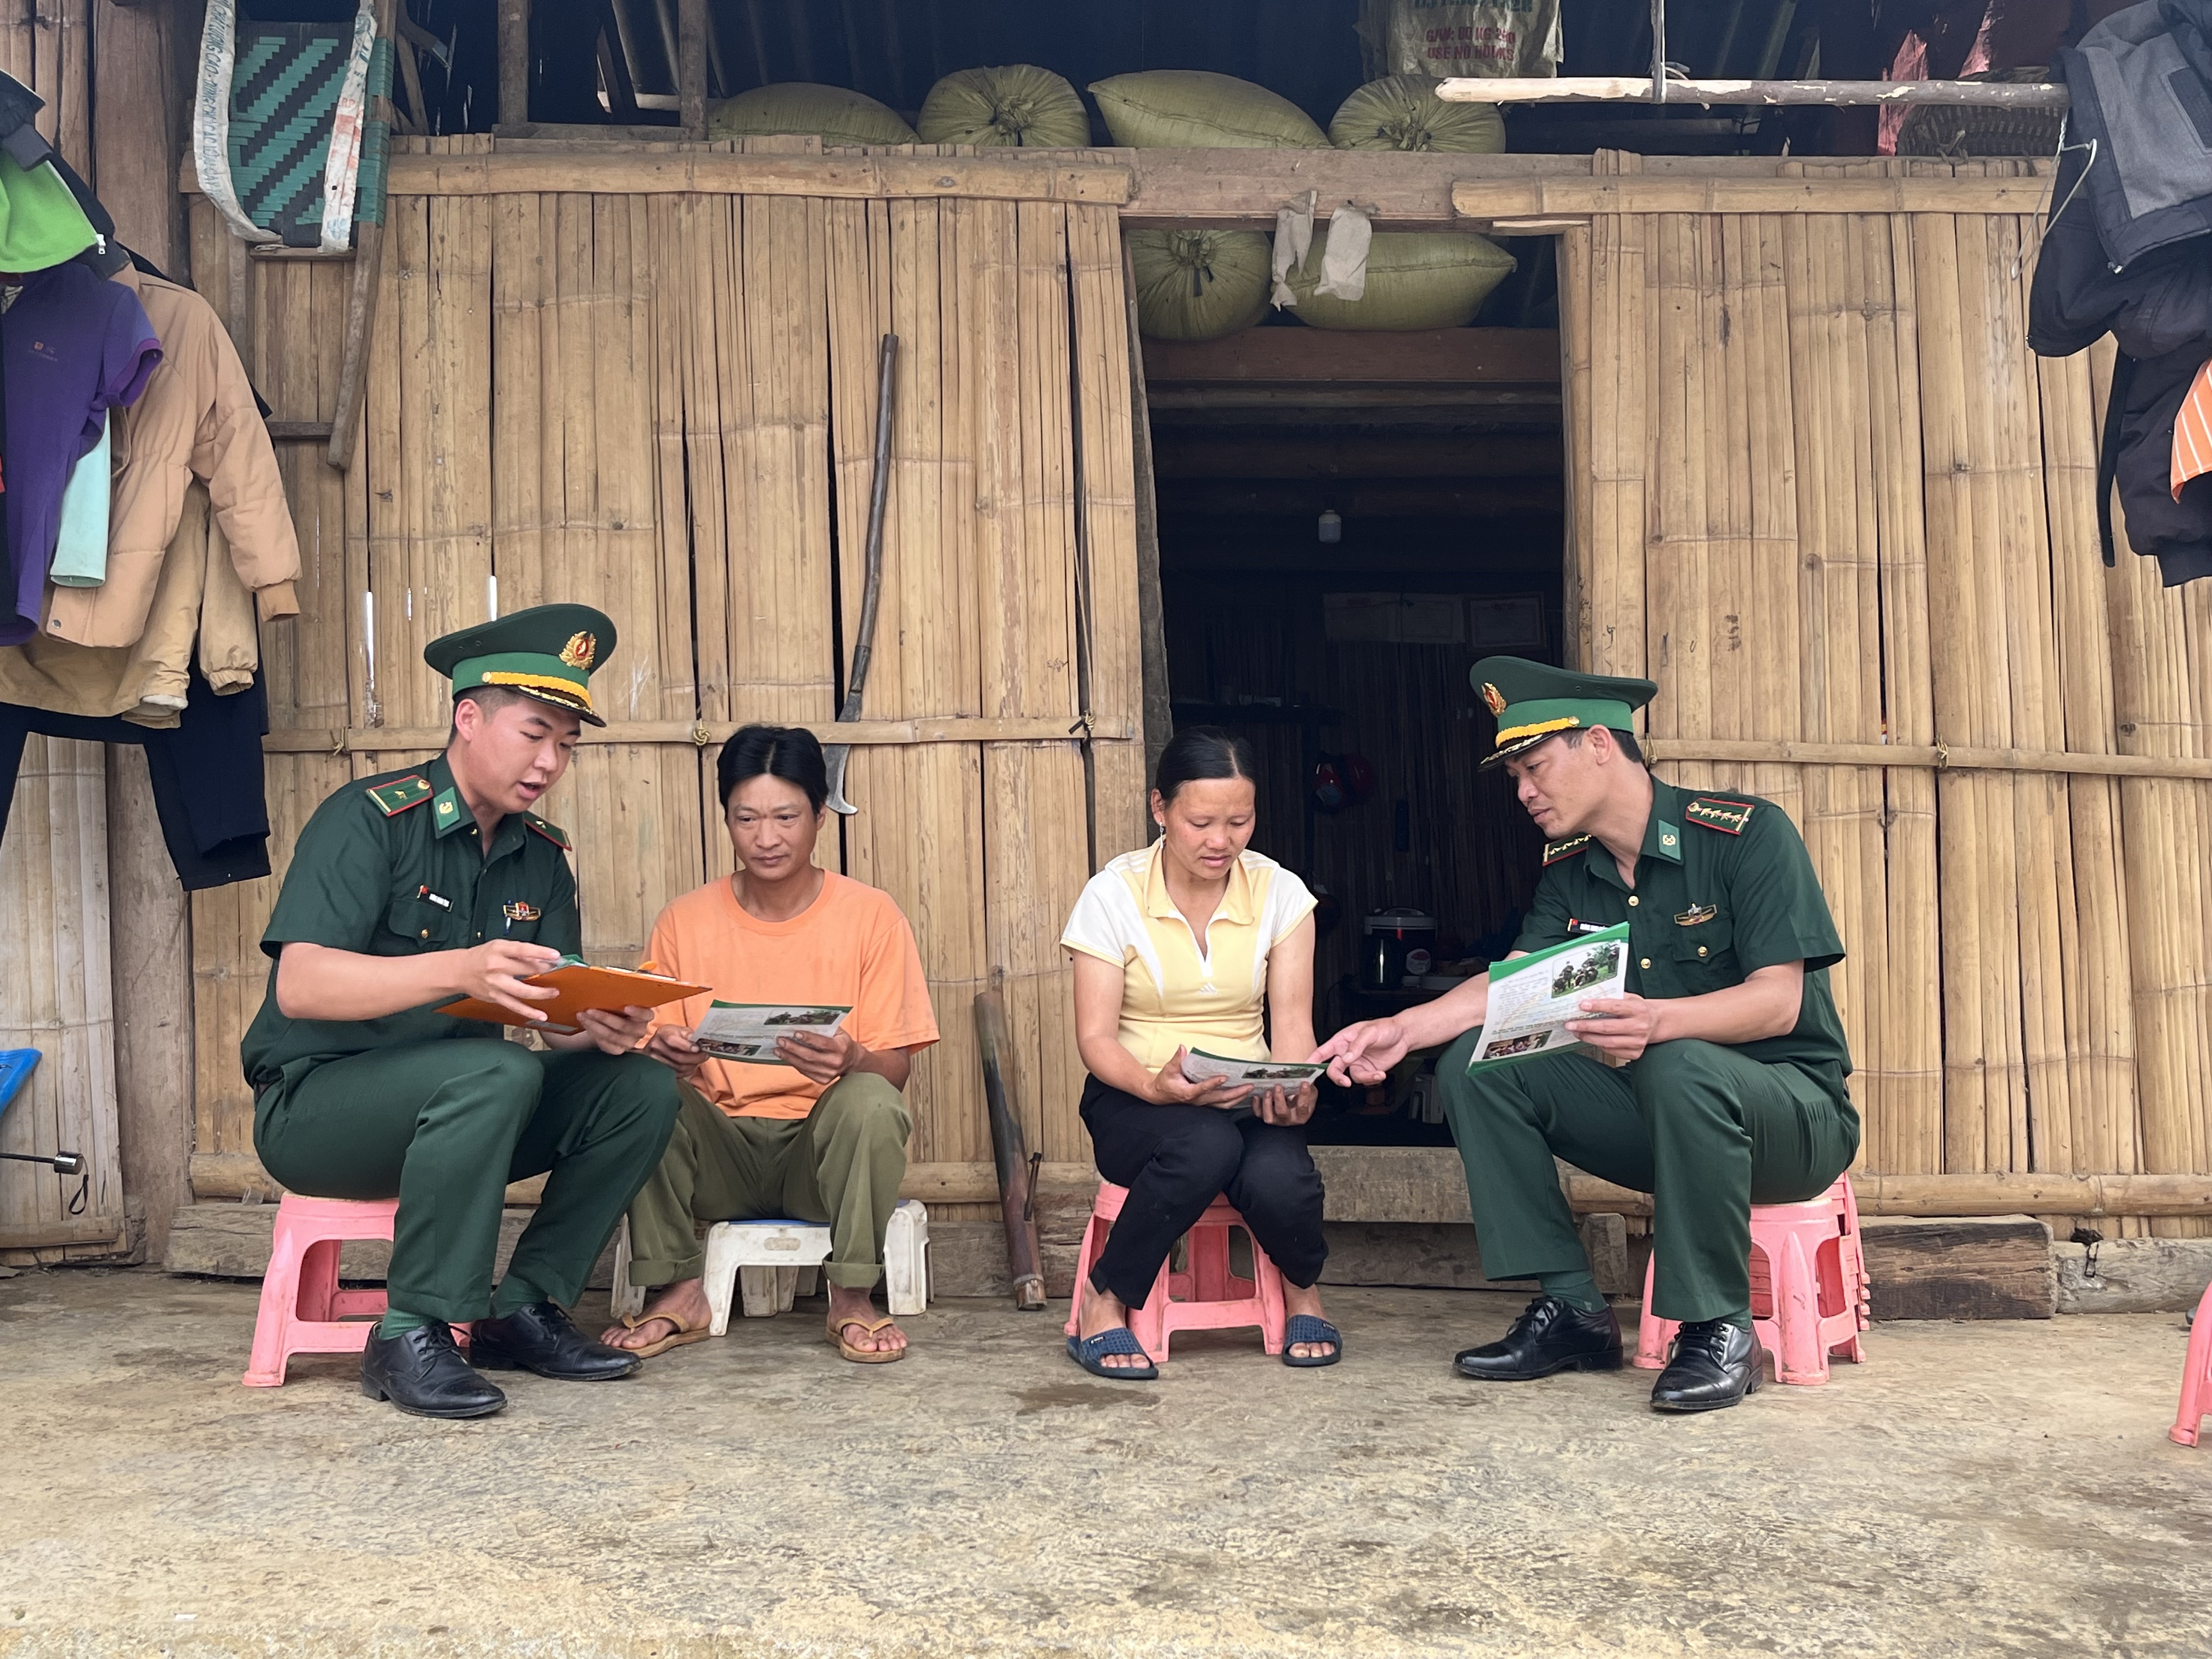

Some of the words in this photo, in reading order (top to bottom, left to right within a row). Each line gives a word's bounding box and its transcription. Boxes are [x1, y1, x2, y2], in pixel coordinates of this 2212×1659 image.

[1427, 46, 1451, 59] USE
[1454, 46, 1471, 59] NO
[205, 53, 221, 74] CAO
